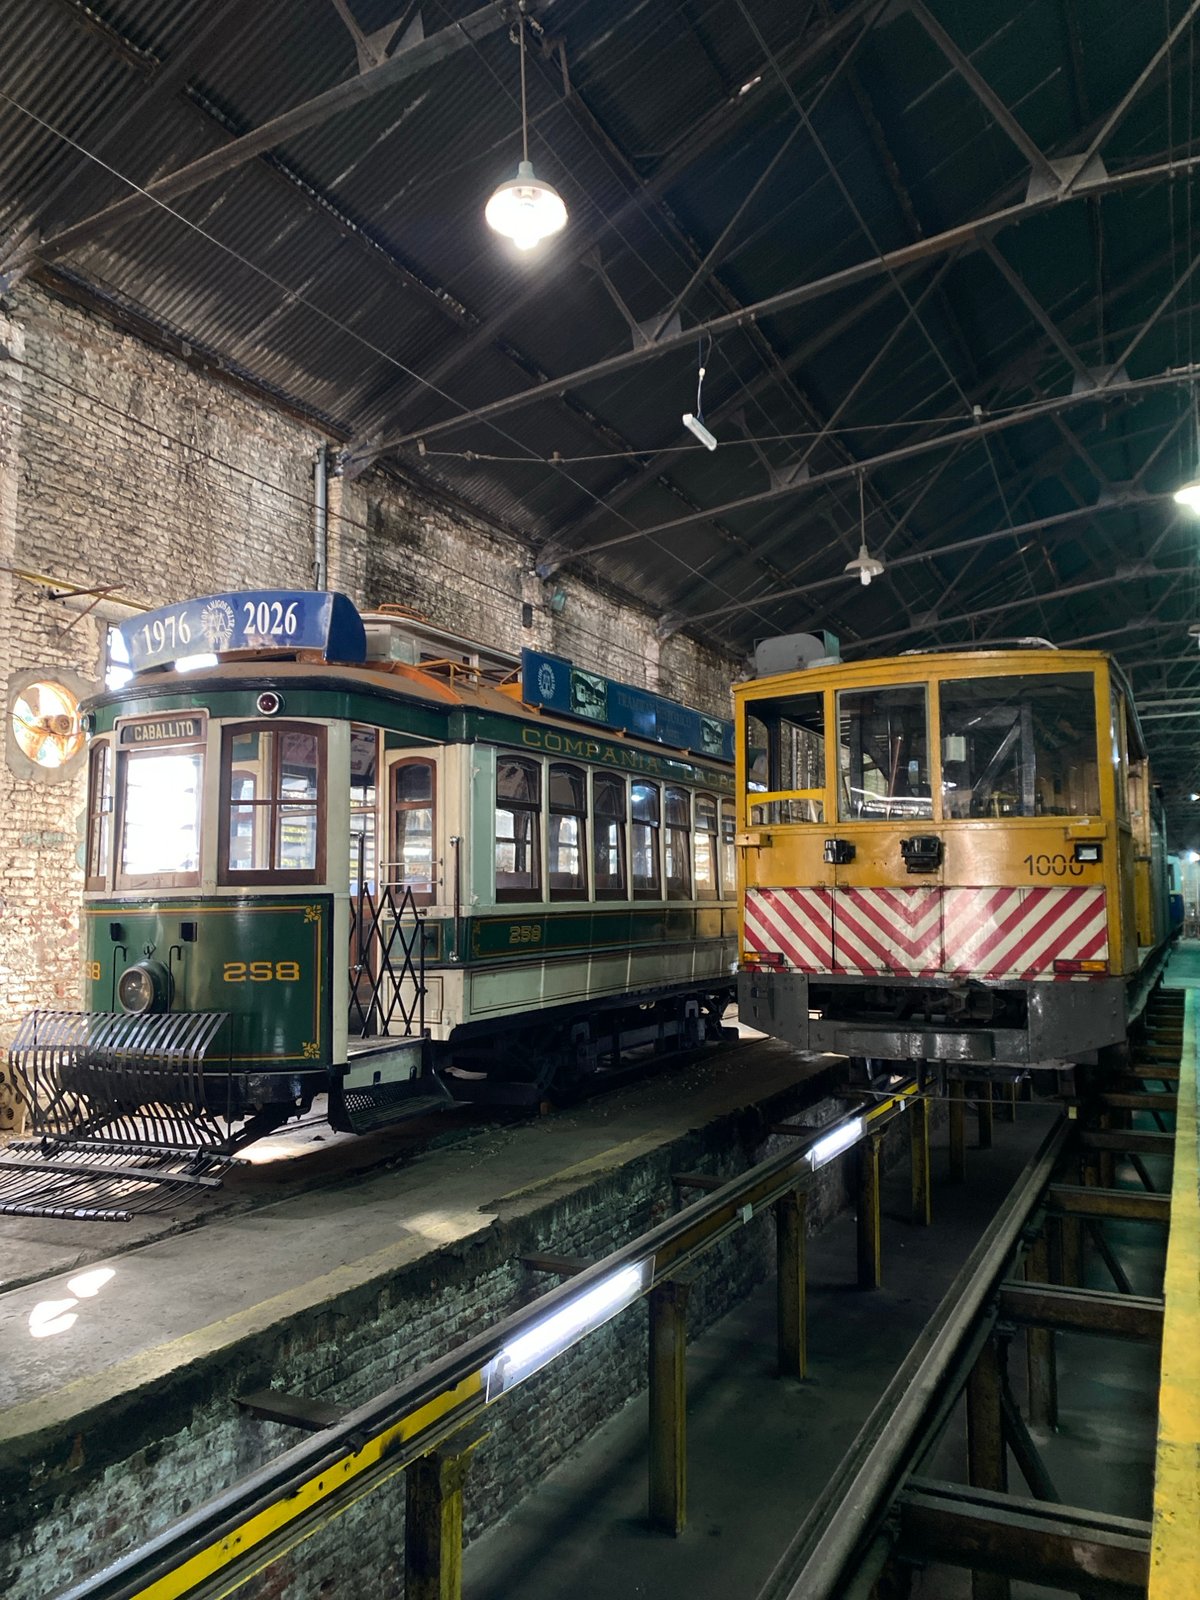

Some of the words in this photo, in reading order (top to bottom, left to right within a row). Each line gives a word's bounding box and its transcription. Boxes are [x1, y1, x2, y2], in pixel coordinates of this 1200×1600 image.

[243, 601, 298, 635] 2026
[142, 611, 190, 655] 1976
[134, 720, 194, 741] CABALLITO
[1023, 854, 1084, 876] 1000
[509, 925, 541, 944] 258
[223, 961, 300, 982] 258
